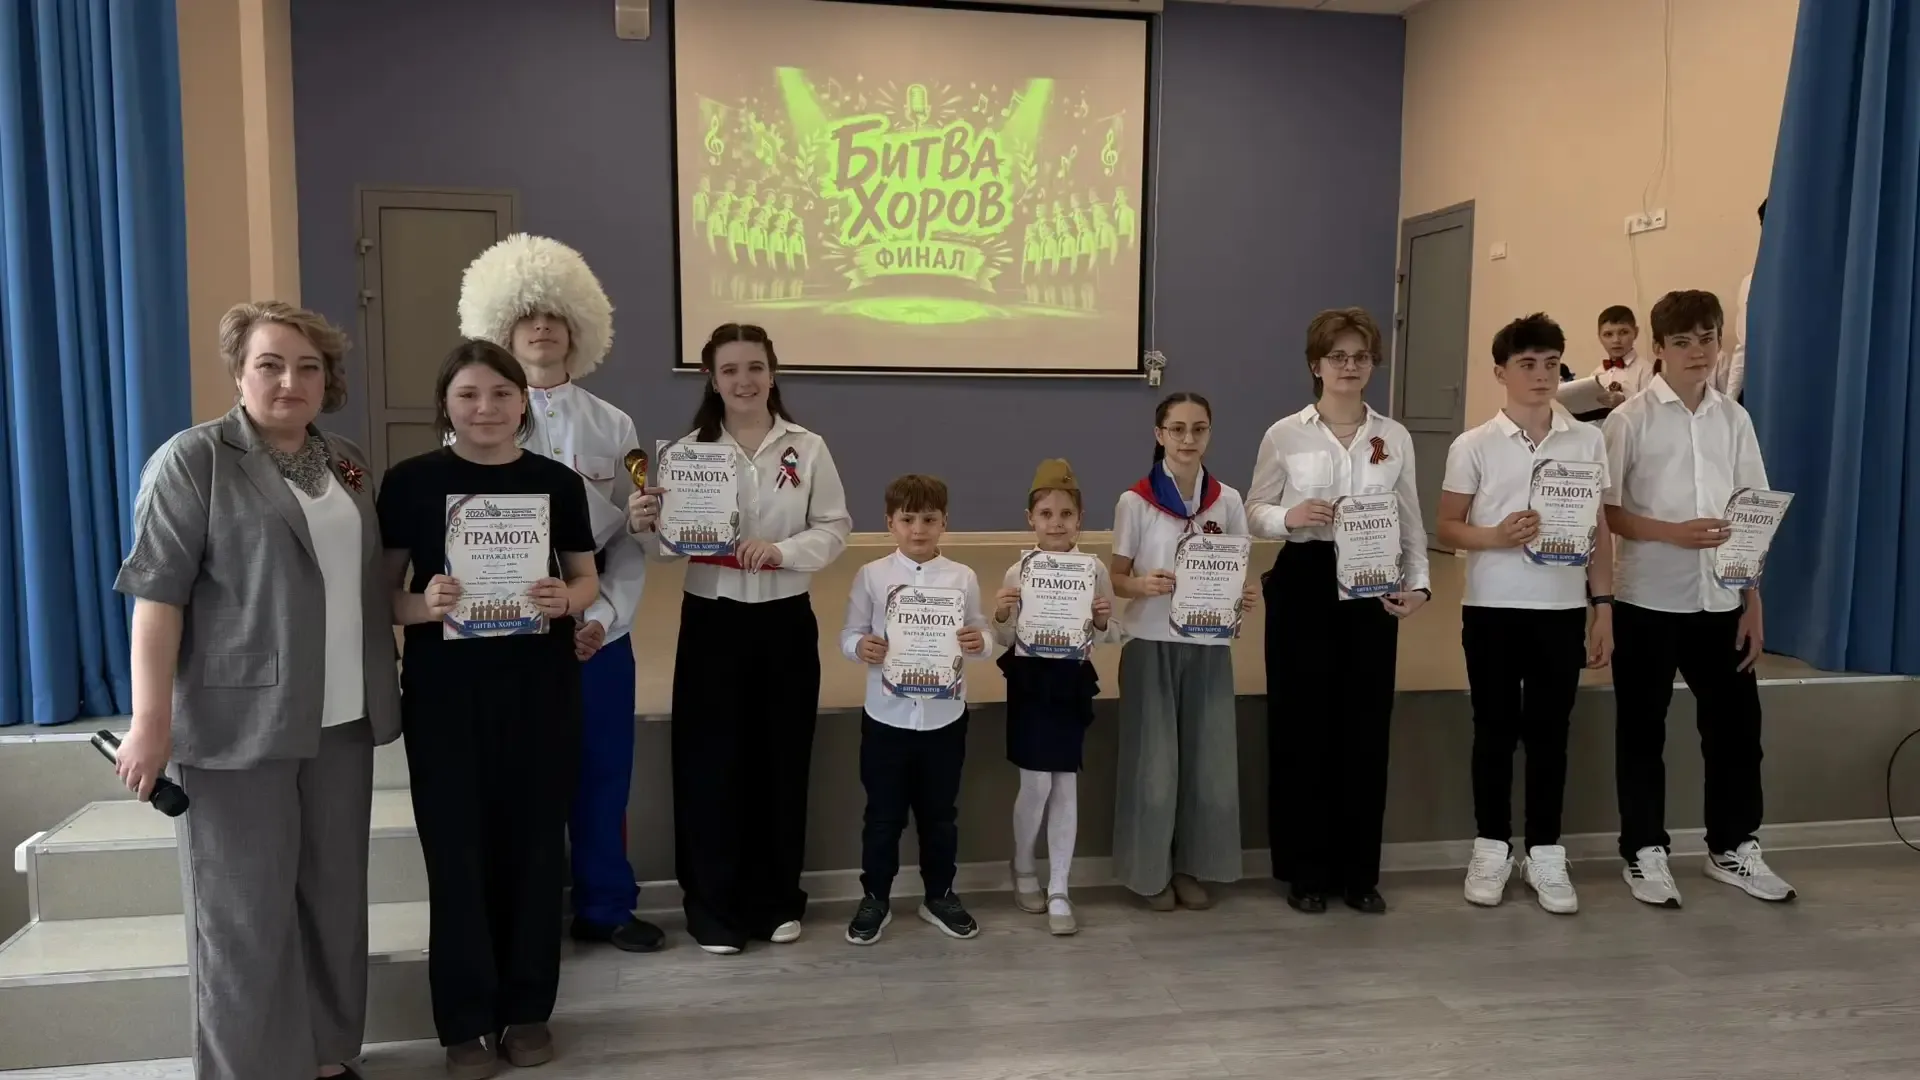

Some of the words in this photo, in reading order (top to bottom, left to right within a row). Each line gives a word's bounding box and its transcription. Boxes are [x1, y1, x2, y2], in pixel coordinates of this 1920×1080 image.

[831, 119, 1003, 191] БИТВА
[846, 182, 1006, 244] ХОРОВ
[874, 245, 966, 272] ФИНАЛ
[671, 469, 729, 482] ГРАМОТА
[1540, 485, 1593, 498] ГРАМОТА
[465, 510, 484, 518] 2026
[1731, 512, 1774, 525] ГРАМОТА
[1343, 517, 1393, 532] ГРАМОТА
[463, 530, 540, 545] ГРАМОТА
[471, 552, 529, 560] НАГРАЖДАЕТСЯ
[1185, 559, 1239, 572] ГРАМОТА
[1031, 577, 1086, 591] ГРАМОТА
[473, 621, 497, 629] БИТВА
[498, 620, 522, 628] ХОРОВ
[898, 612, 956, 626] ГРАМОТА
